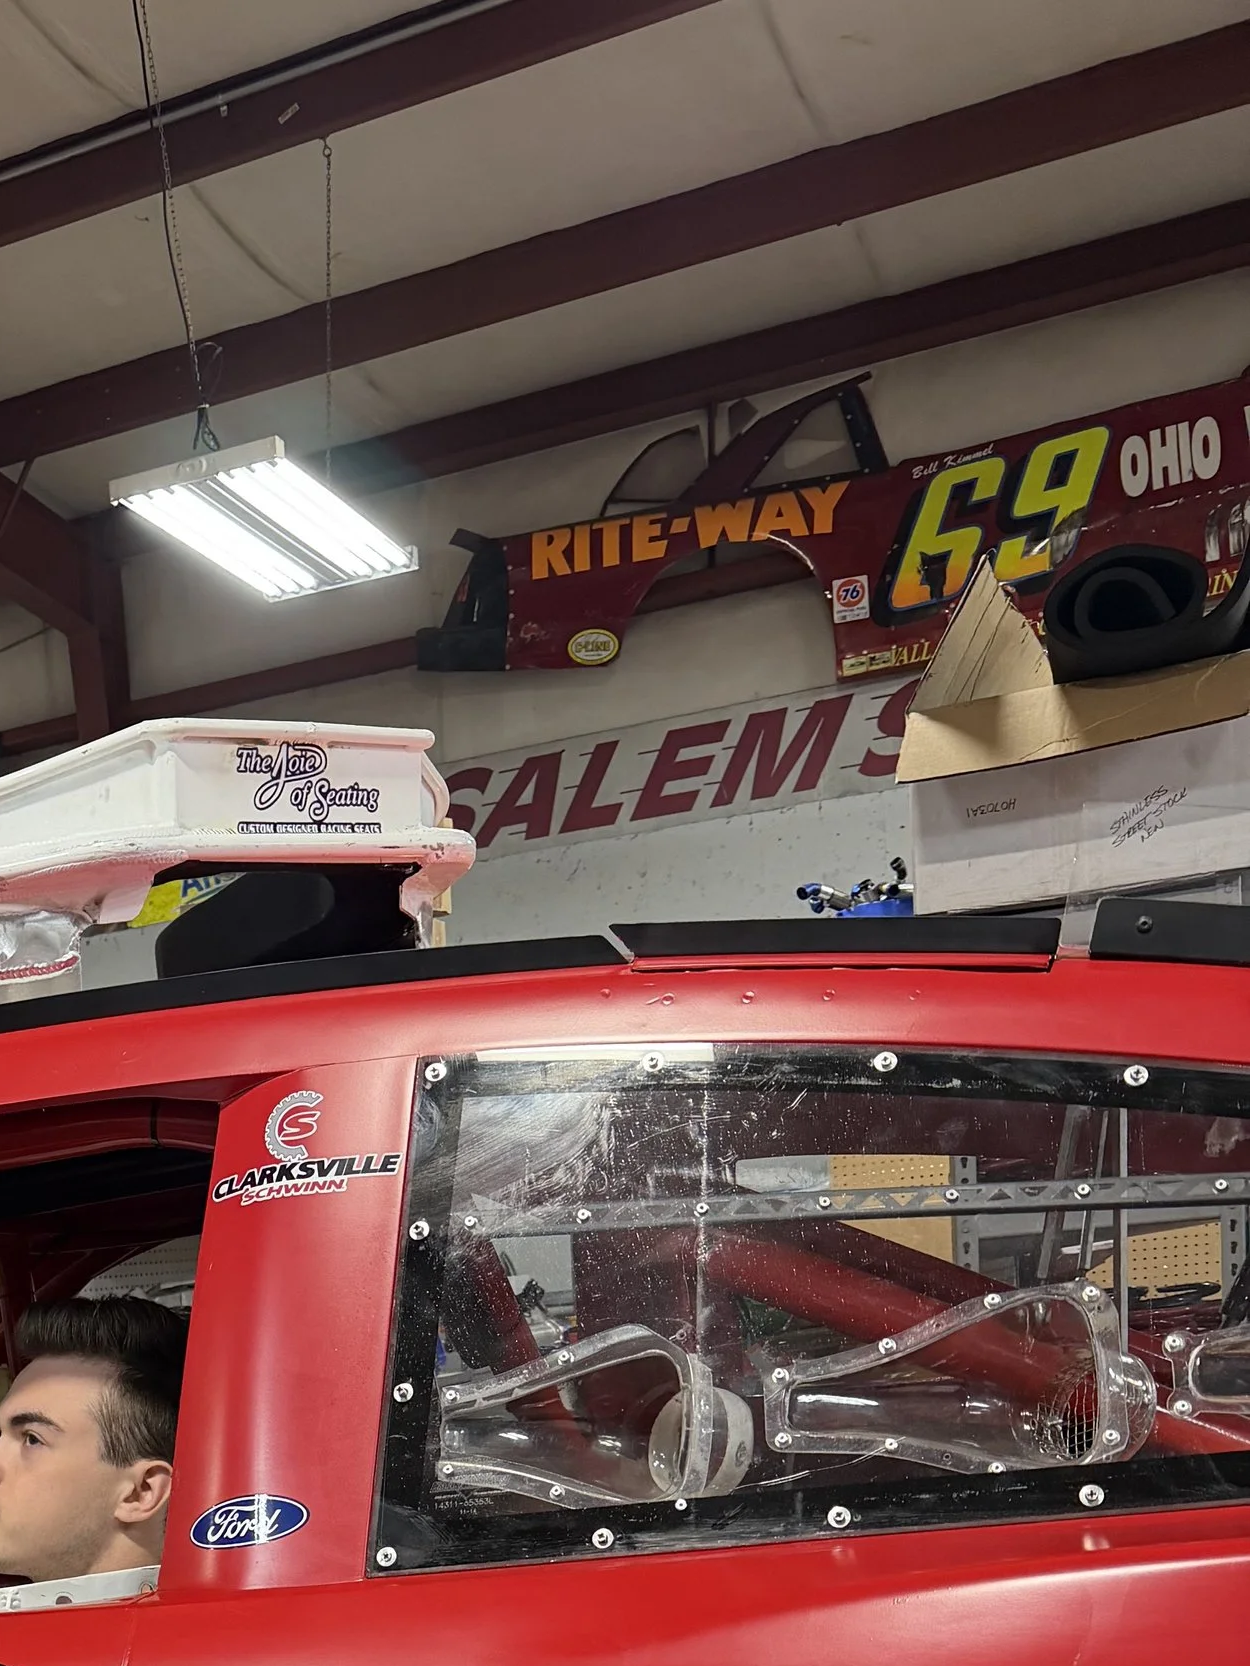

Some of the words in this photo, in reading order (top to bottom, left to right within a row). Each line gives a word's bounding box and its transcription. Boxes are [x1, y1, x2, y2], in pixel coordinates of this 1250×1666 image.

[912, 462, 939, 479] Bill
[943, 443, 994, 468] Kimmel
[1119, 416, 1222, 498] OHIO
[531, 480, 851, 580] RITE-WAY
[884, 425, 1112, 612] 69
[840, 583, 862, 604] 76
[237, 748, 273, 773] The
[443, 693, 854, 850] SALEM
[290, 780, 313, 812] of
[308, 778, 380, 822] Seating
[1152, 787, 1187, 817] STOCK
[213, 1153, 402, 1199] CLARKSVILLE
[242, 1178, 347, 1204] SCHWINN
[207, 1505, 281, 1543] Ford
